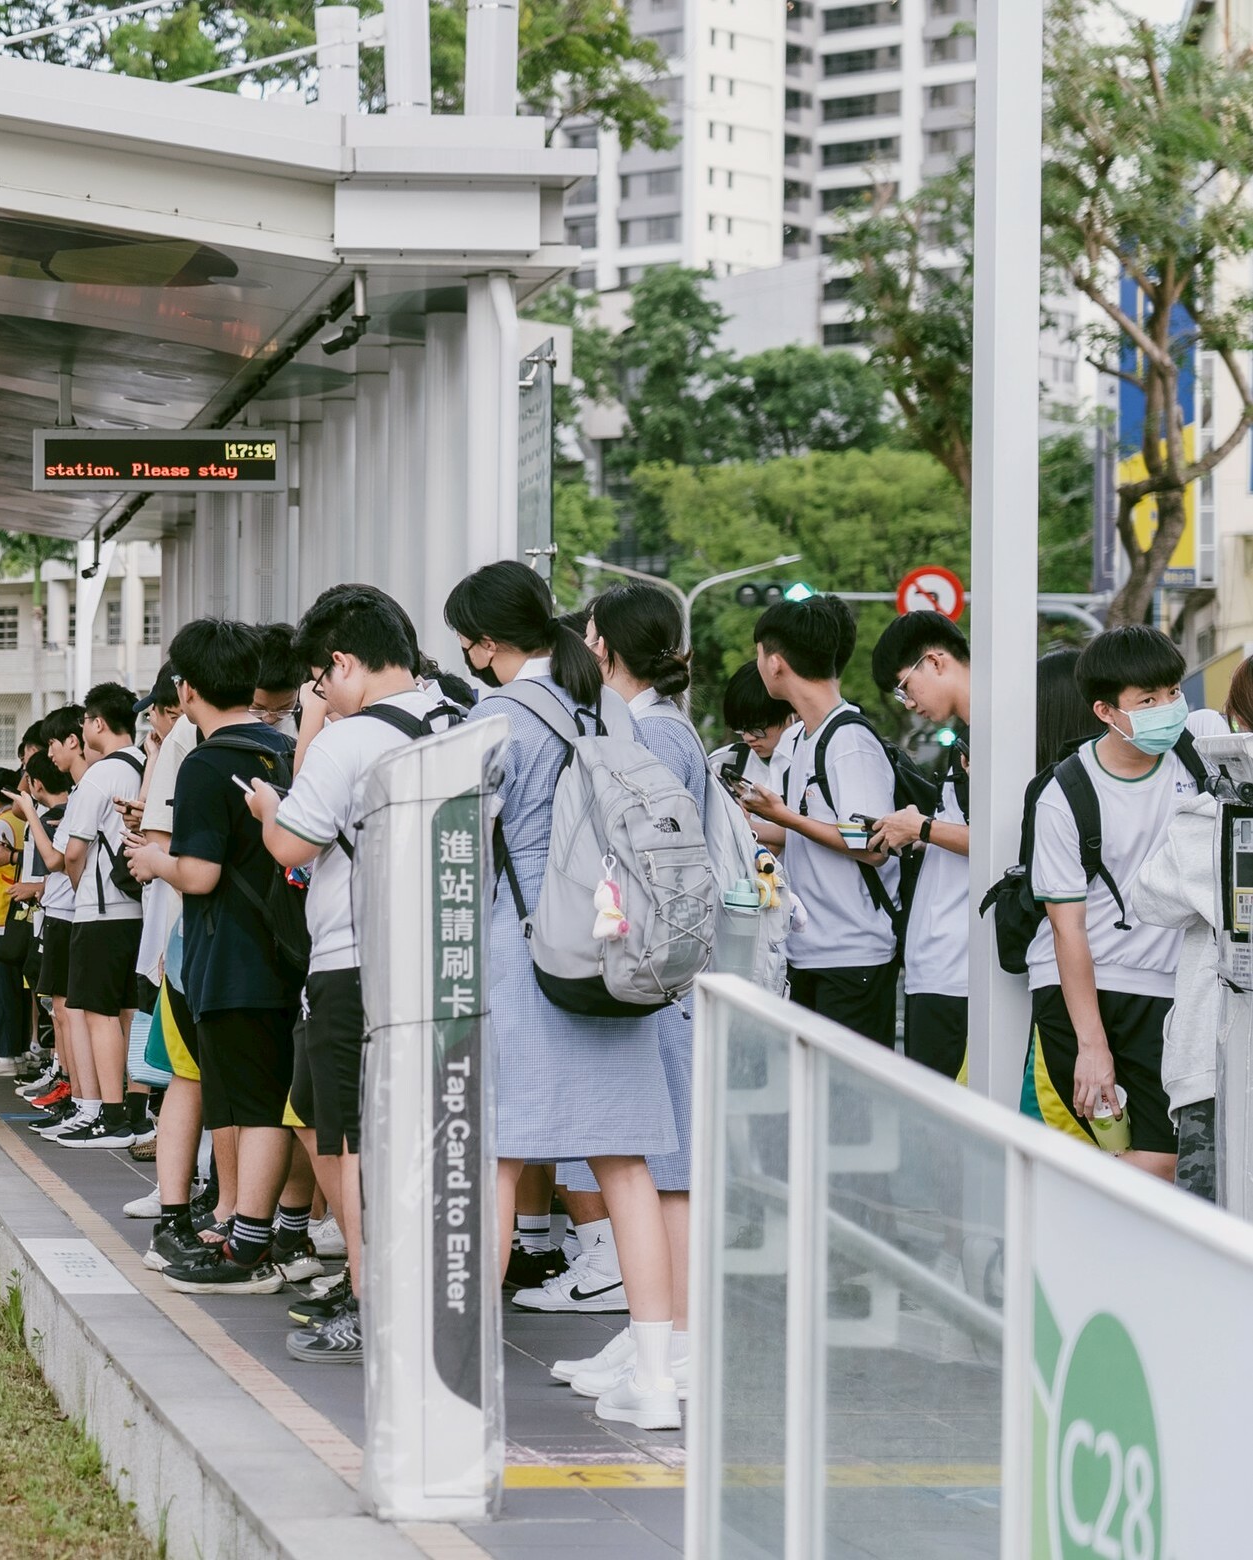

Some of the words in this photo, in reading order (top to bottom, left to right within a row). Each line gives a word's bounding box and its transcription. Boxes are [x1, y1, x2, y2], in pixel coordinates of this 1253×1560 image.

[46, 463, 121, 477] station.
[132, 463, 190, 477] Please
[198, 464, 238, 479] stay
[230, 443, 274, 459] 17:19
[439, 829, 475, 1019] 進站請刷卡
[442, 1056, 471, 1113] Tap
[447, 1119, 472, 1189] Card
[447, 1195, 471, 1227] to
[447, 1233, 471, 1315] Enter
[1060, 1418, 1155, 1560] C28
